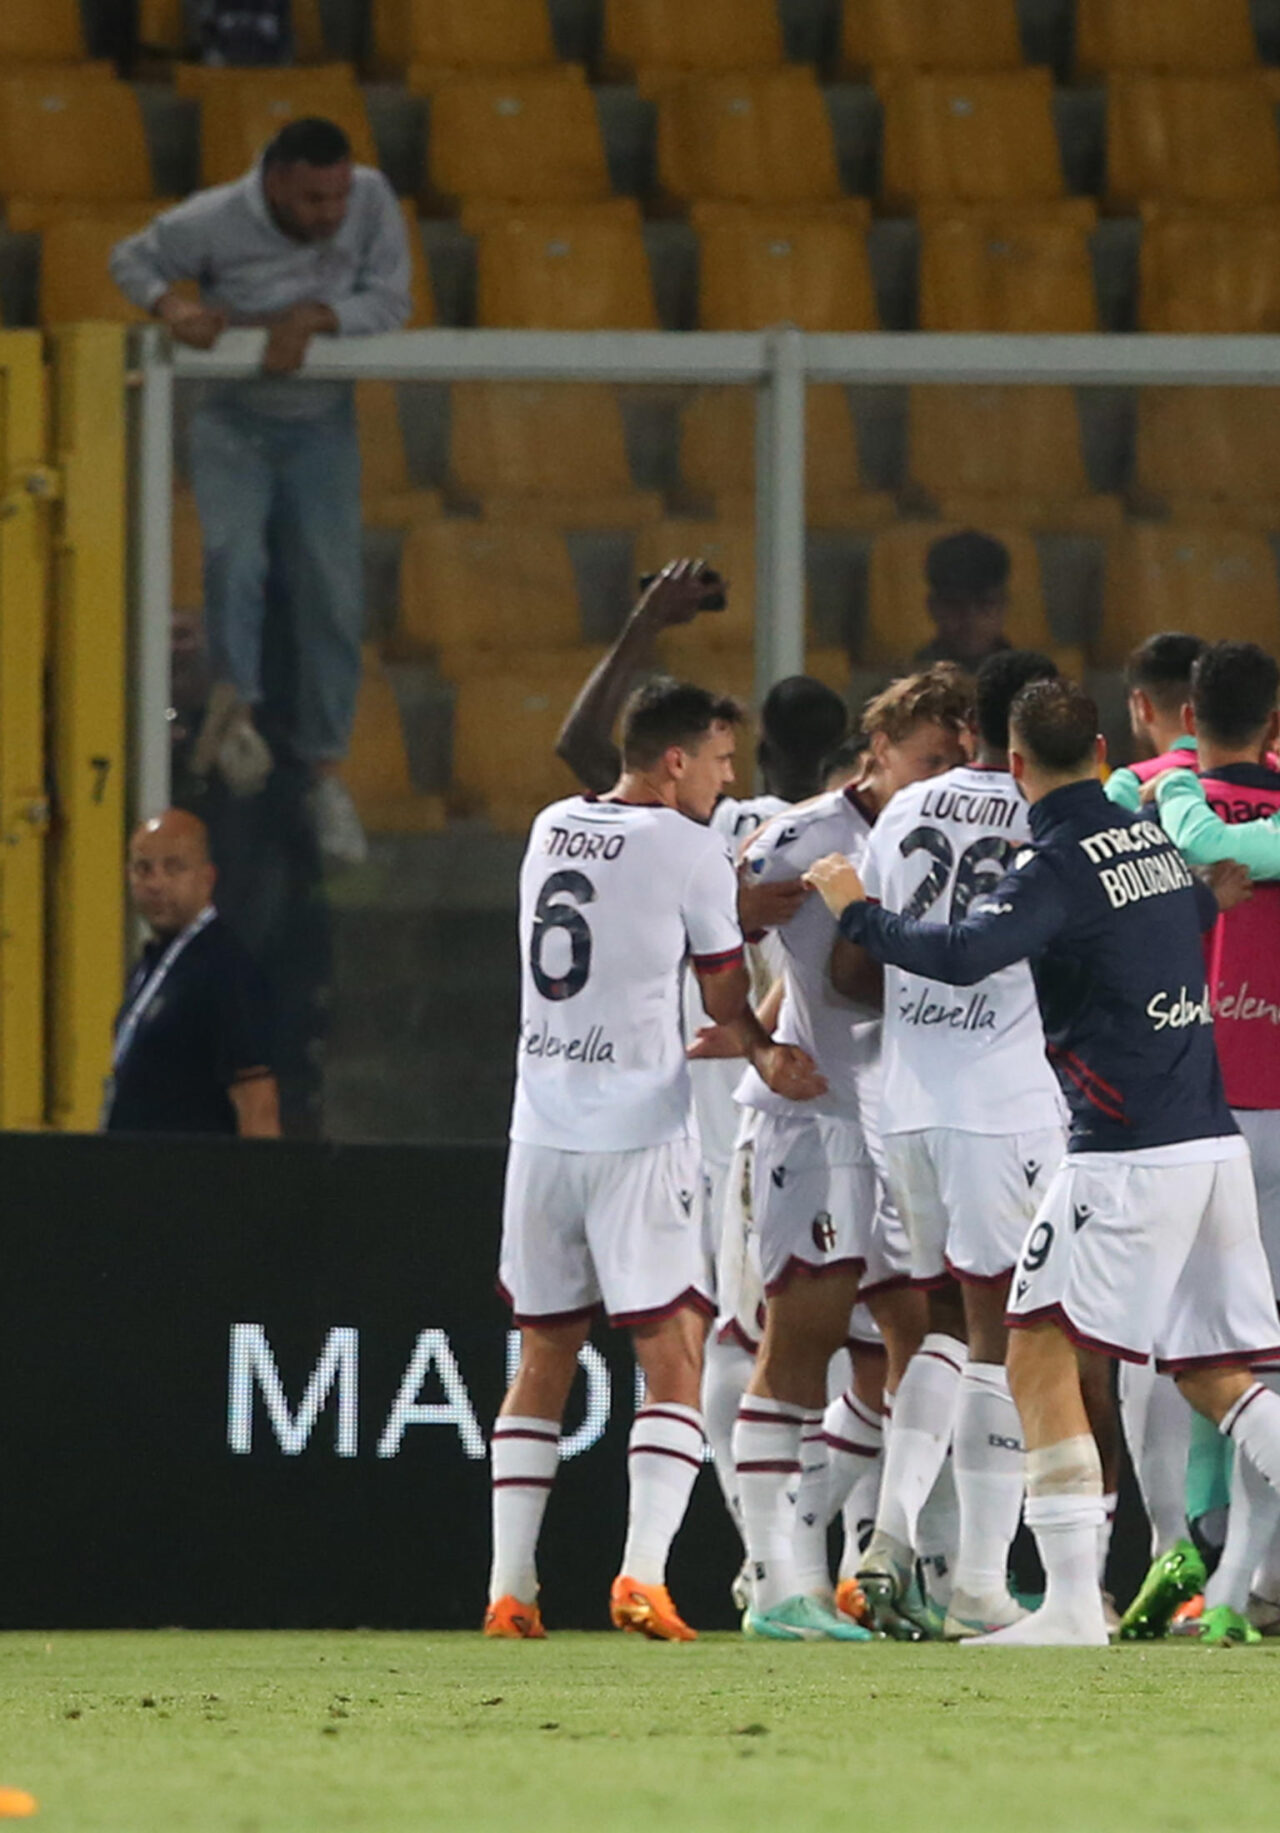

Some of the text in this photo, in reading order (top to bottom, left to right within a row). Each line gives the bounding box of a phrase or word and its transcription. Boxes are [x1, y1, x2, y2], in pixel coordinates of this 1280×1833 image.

[920, 789, 1019, 828] LUCUMI
[1079, 820, 1168, 864] macro
[530, 869, 598, 1002] 6
[900, 986, 996, 1030] elenella
[521, 1021, 616, 1064] elenella
[1022, 1221, 1055, 1272] 9
[227, 1323, 714, 1461] MAD
